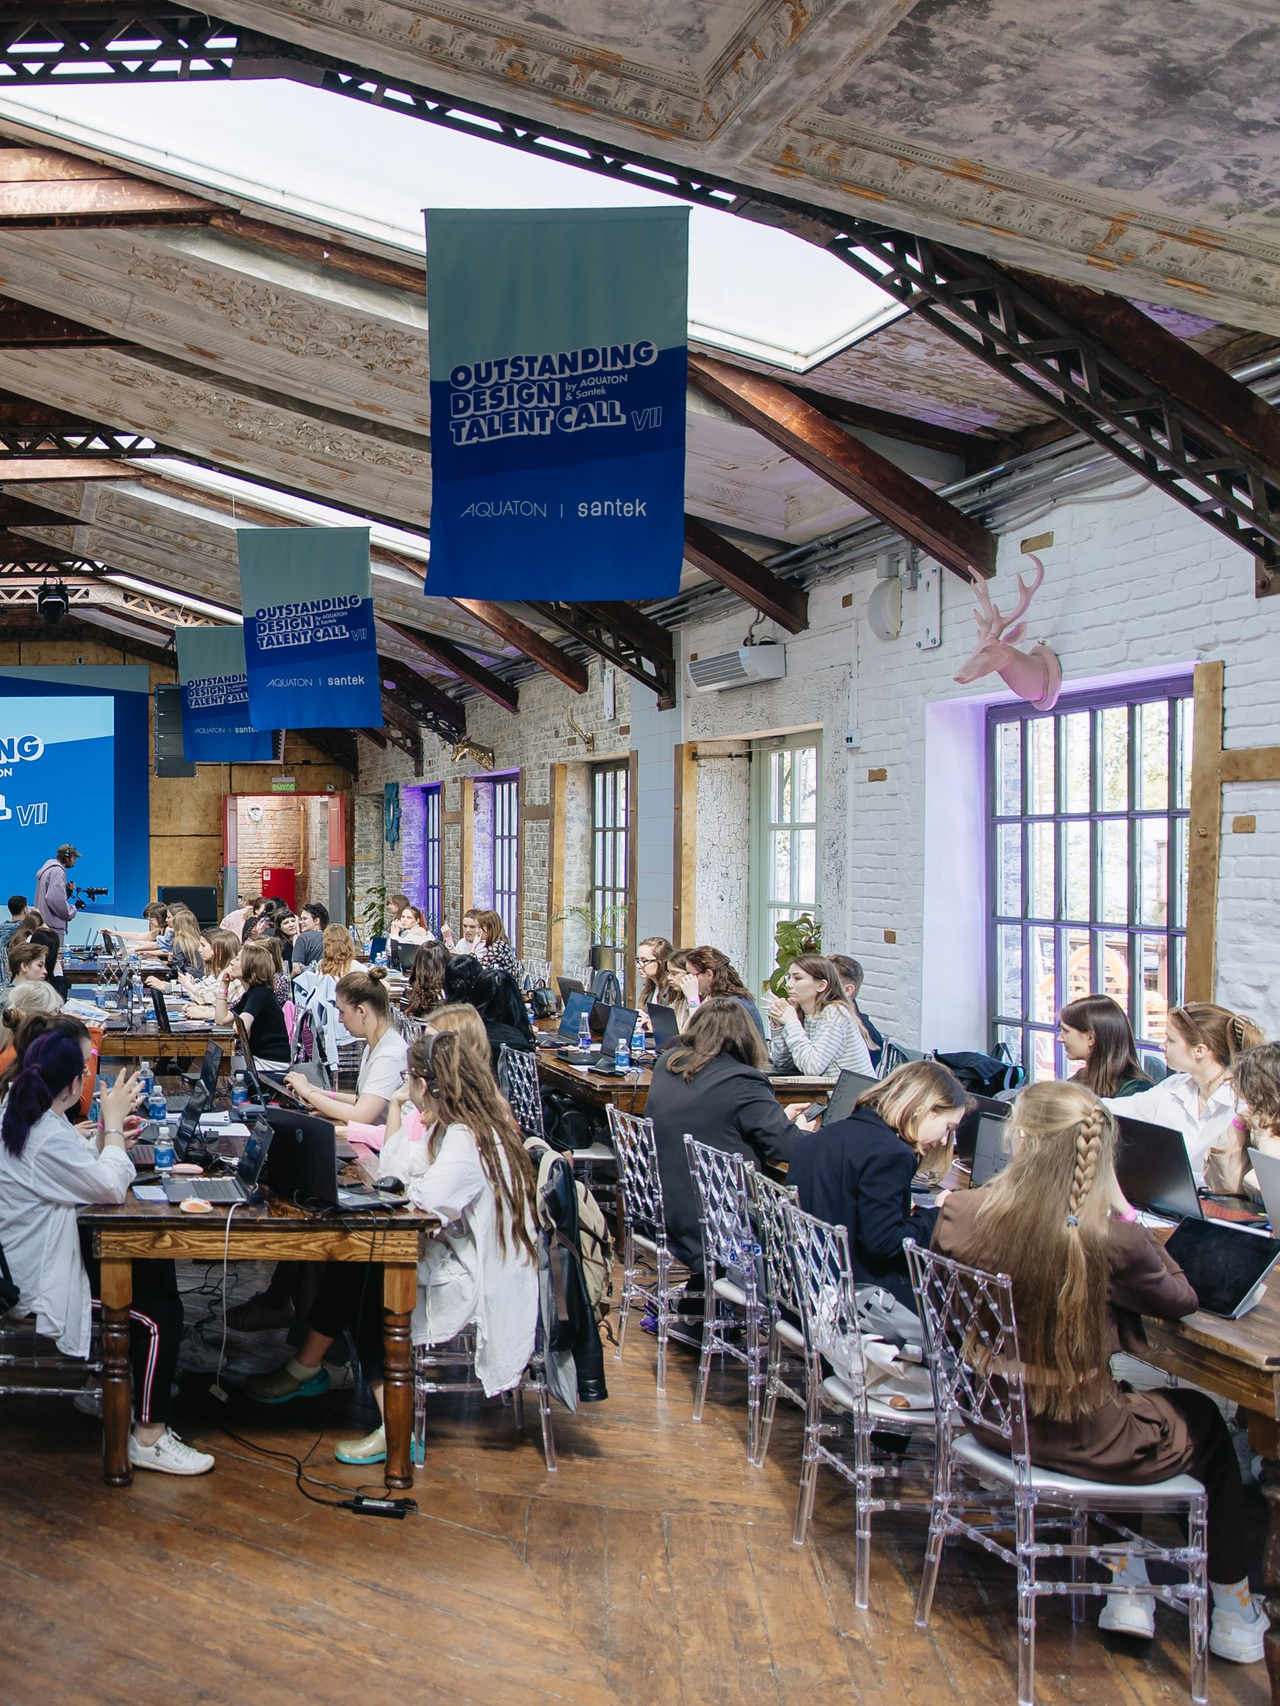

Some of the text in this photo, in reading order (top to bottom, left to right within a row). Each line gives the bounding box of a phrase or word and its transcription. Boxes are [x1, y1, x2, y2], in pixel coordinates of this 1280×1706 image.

[449, 339, 658, 390] OUTSTANDING
[565, 374, 628, 392] by AQUATON
[450, 380, 560, 418] DESIGN
[565, 386, 606, 401] & Santek
[450, 400, 662, 445] TALENT CALL VII
[460, 498, 647, 518] AQUATON santek
[255, 594, 362, 621] OUTSTANDING
[322, 611, 348, 620] AQUATON
[256, 615, 314, 636] DESIGN
[257, 630, 312, 650] TALENT
[312, 624, 349, 642] CALL
[187, 672, 247, 689] OUTSTANDIN
[267, 675, 365, 688] AQUATON santek
[187, 685, 226, 699] DESIGN
[188, 692, 249, 709] TALENT CALL
[16, 802, 48, 827] VII
